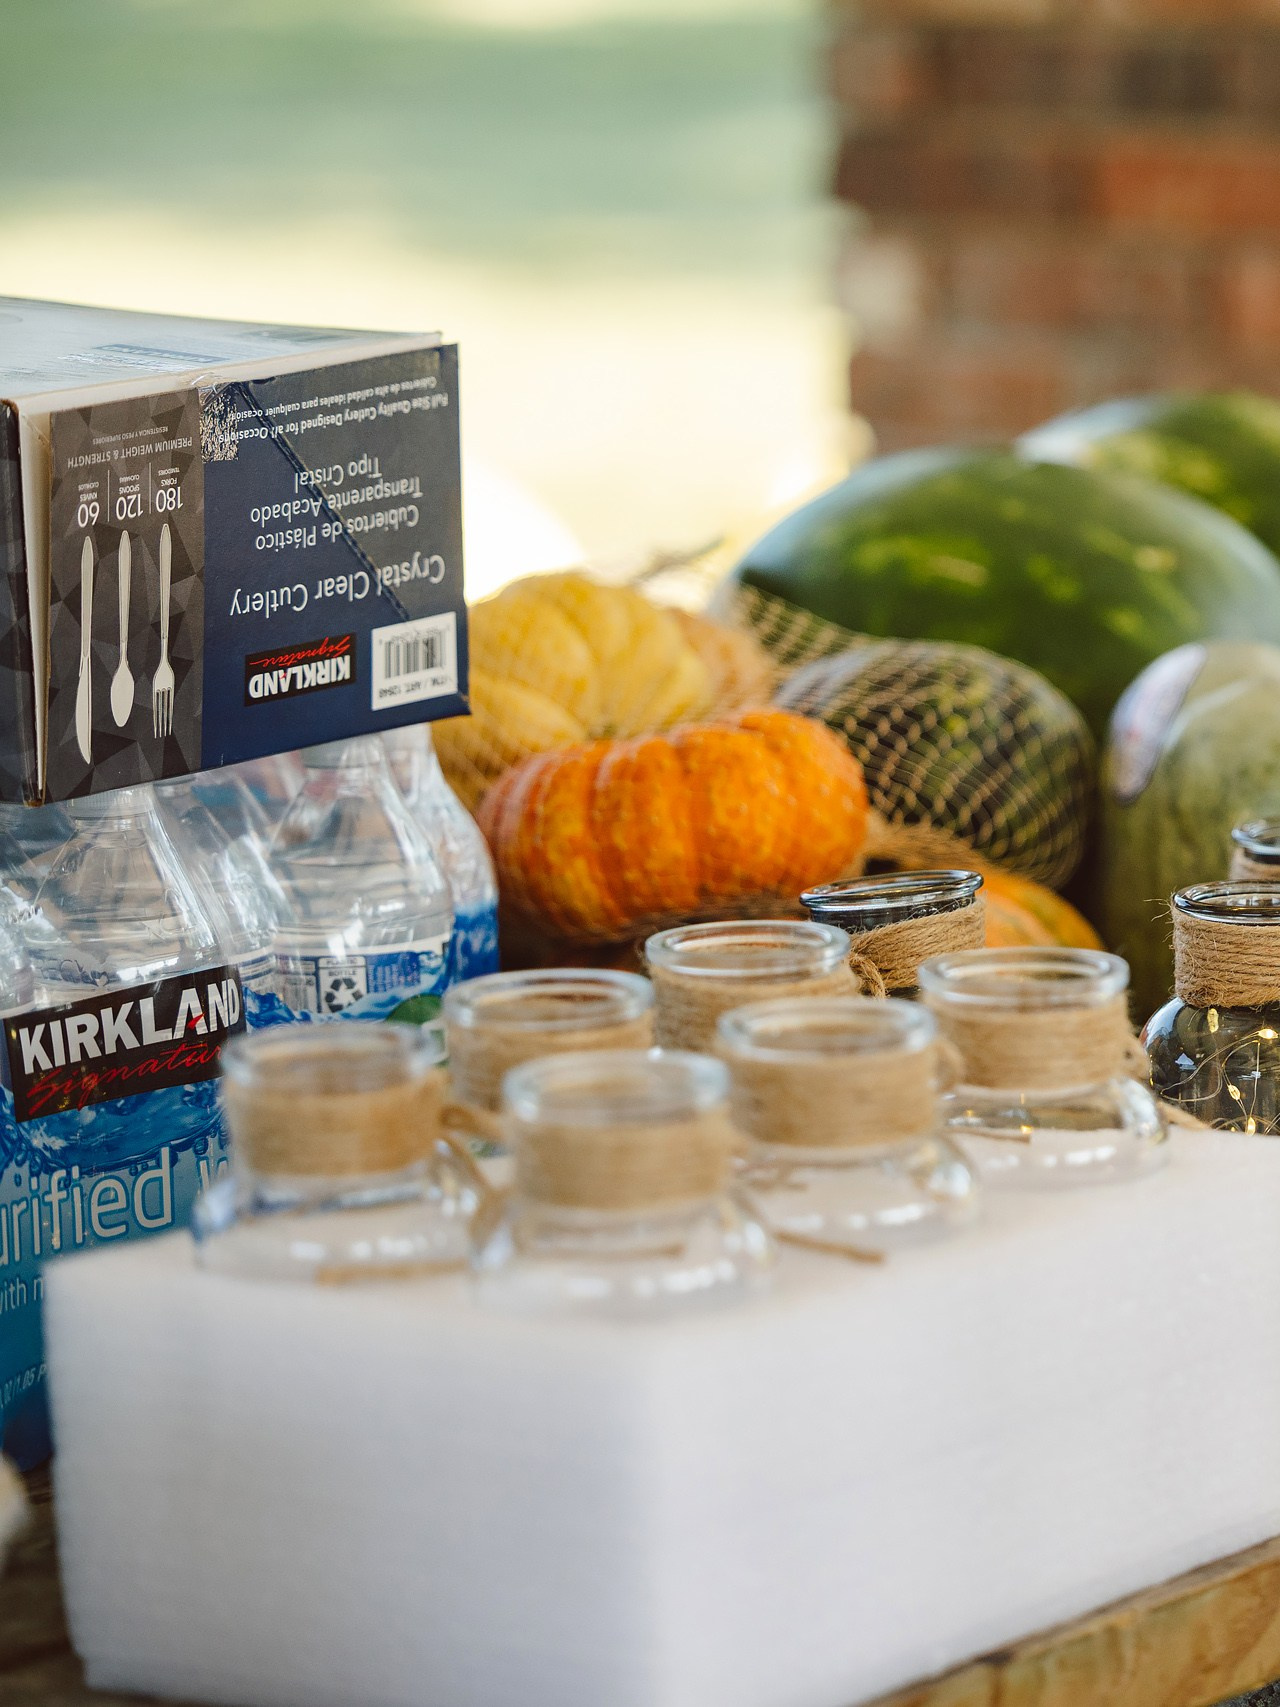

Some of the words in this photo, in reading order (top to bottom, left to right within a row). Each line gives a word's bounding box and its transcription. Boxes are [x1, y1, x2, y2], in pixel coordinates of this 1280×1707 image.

[265, 400, 301, 417] cualquier
[301, 396, 319, 411] para
[319, 391, 346, 407] ideales
[378, 398, 412, 417] Quality
[286, 421, 299, 434] for
[301, 412, 343, 434] Designed
[344, 406, 377, 424] Cutlery
[113, 449, 119, 460] &
[120, 444, 154, 459] WEIGHT
[155, 436, 193, 453] PREMIUM
[67, 452, 111, 470] STRENGTH
[350, 453, 382, 478] Tipo
[119, 484, 140, 495] SPOONS
[161, 477, 178, 487] FORKS
[294, 464, 344, 494] Cristal
[80, 491, 98, 502] KNIVES
[156, 486, 184, 513] 180
[328, 476, 424, 510] Transparente
[77, 501, 100, 528] 60
[116, 494, 144, 521] 120
[251, 497, 323, 529] Acabado
[347, 504, 420, 534] Cubiertos
[255, 524, 317, 552] Plástico
[322, 521, 343, 543] de
[314, 570, 370, 602] Clear
[376, 551, 446, 596] Crystal
[229, 583, 309, 618] Cutlery
[249, 635, 351, 667] Signature
[248, 654, 351, 699] KIRKLAND
[19, 978, 240, 1076] KIRKLAND
[26, 1042, 223, 1116] Signatur
